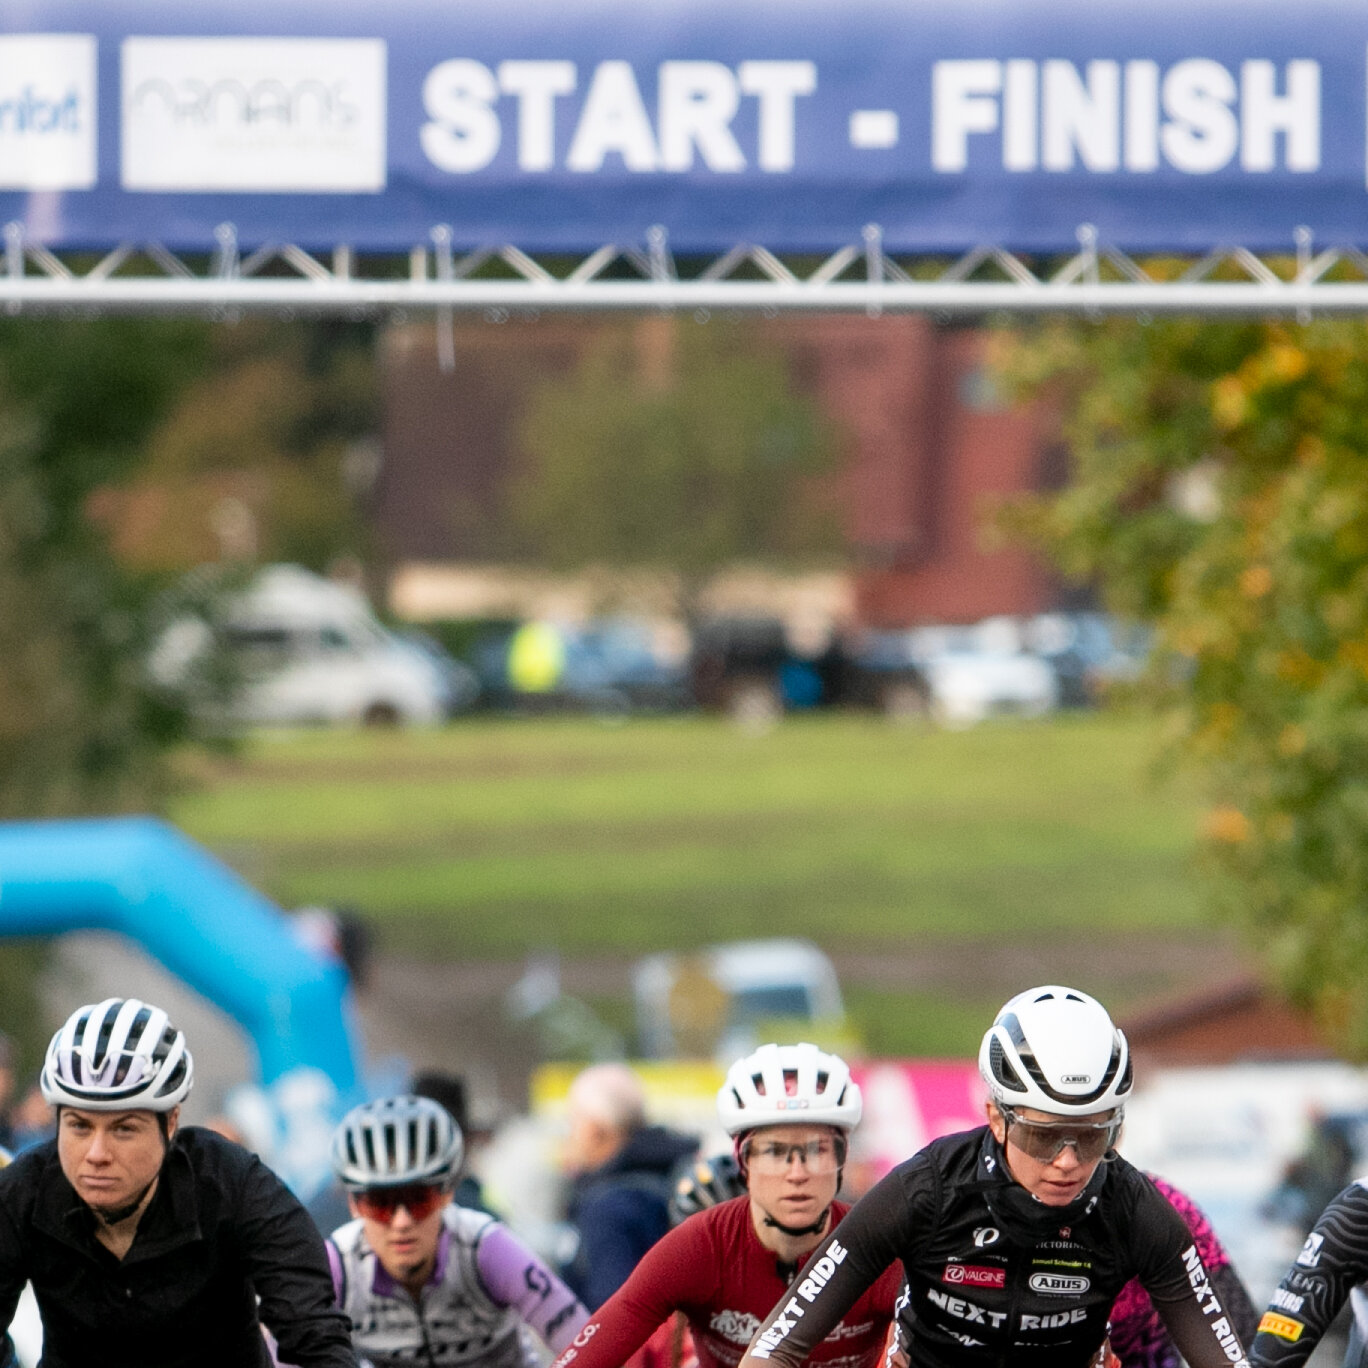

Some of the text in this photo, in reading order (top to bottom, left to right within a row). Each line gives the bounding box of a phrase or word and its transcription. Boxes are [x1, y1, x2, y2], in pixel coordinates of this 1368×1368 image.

[421, 56, 1322, 175] START - FINISH
[964, 1270, 1006, 1284] VALGINE
[1038, 1277, 1082, 1290] ABUS
[1181, 1244, 1222, 1315] NEXT
[750, 1296, 805, 1360] NEXT
[797, 1239, 848, 1303] RIDE
[927, 1287, 1088, 1331] NEXT RIDE
[573, 1323, 601, 1348] Co.
